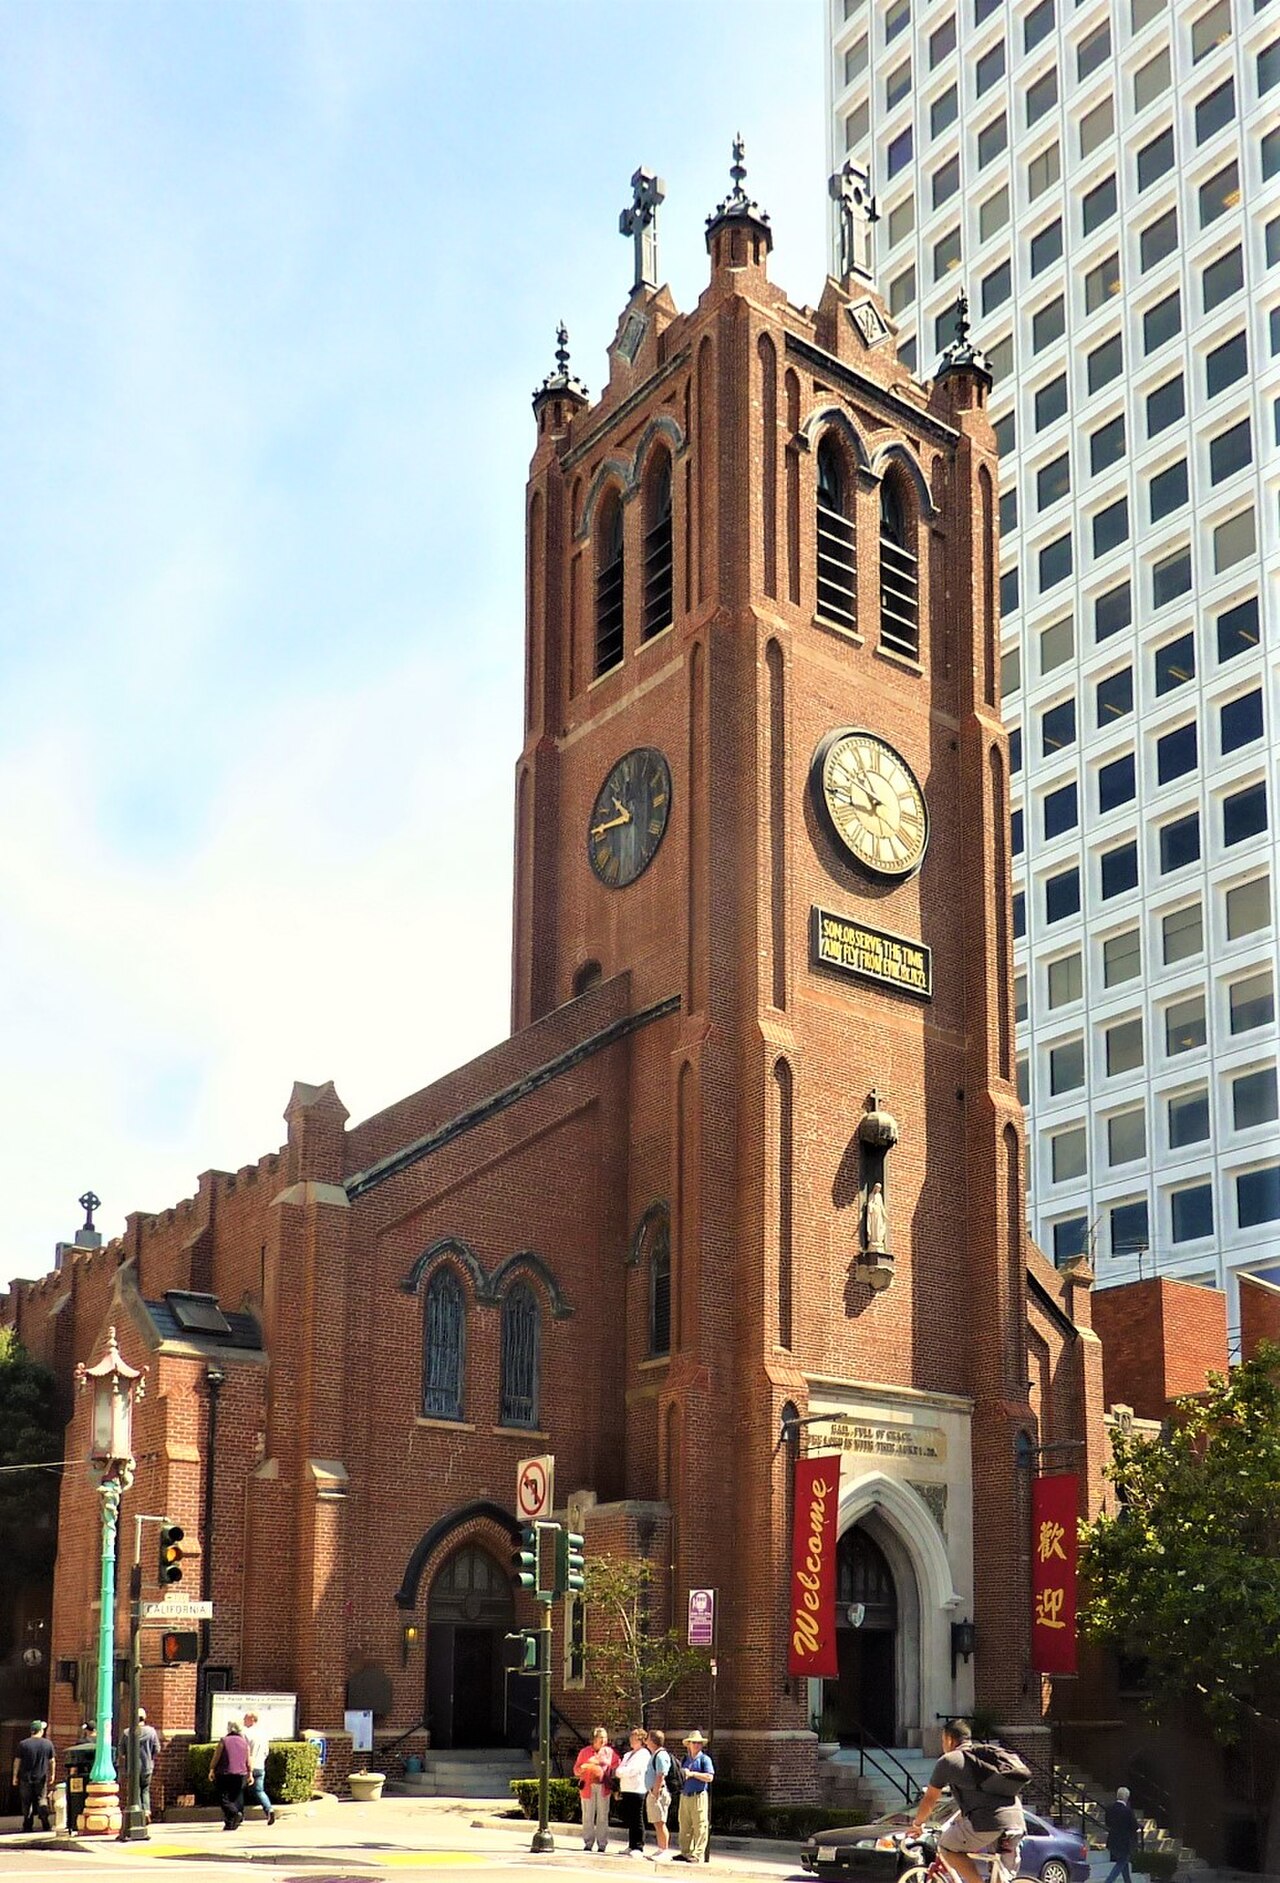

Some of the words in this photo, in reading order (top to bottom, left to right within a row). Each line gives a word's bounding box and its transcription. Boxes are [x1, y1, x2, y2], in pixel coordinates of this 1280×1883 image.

[883, 940, 901, 962] THE
[793, 1477, 828, 1656] Welcome
[1036, 1520, 1067, 1629] 歡迎
[147, 1604, 206, 1615] CALIFORNIA
